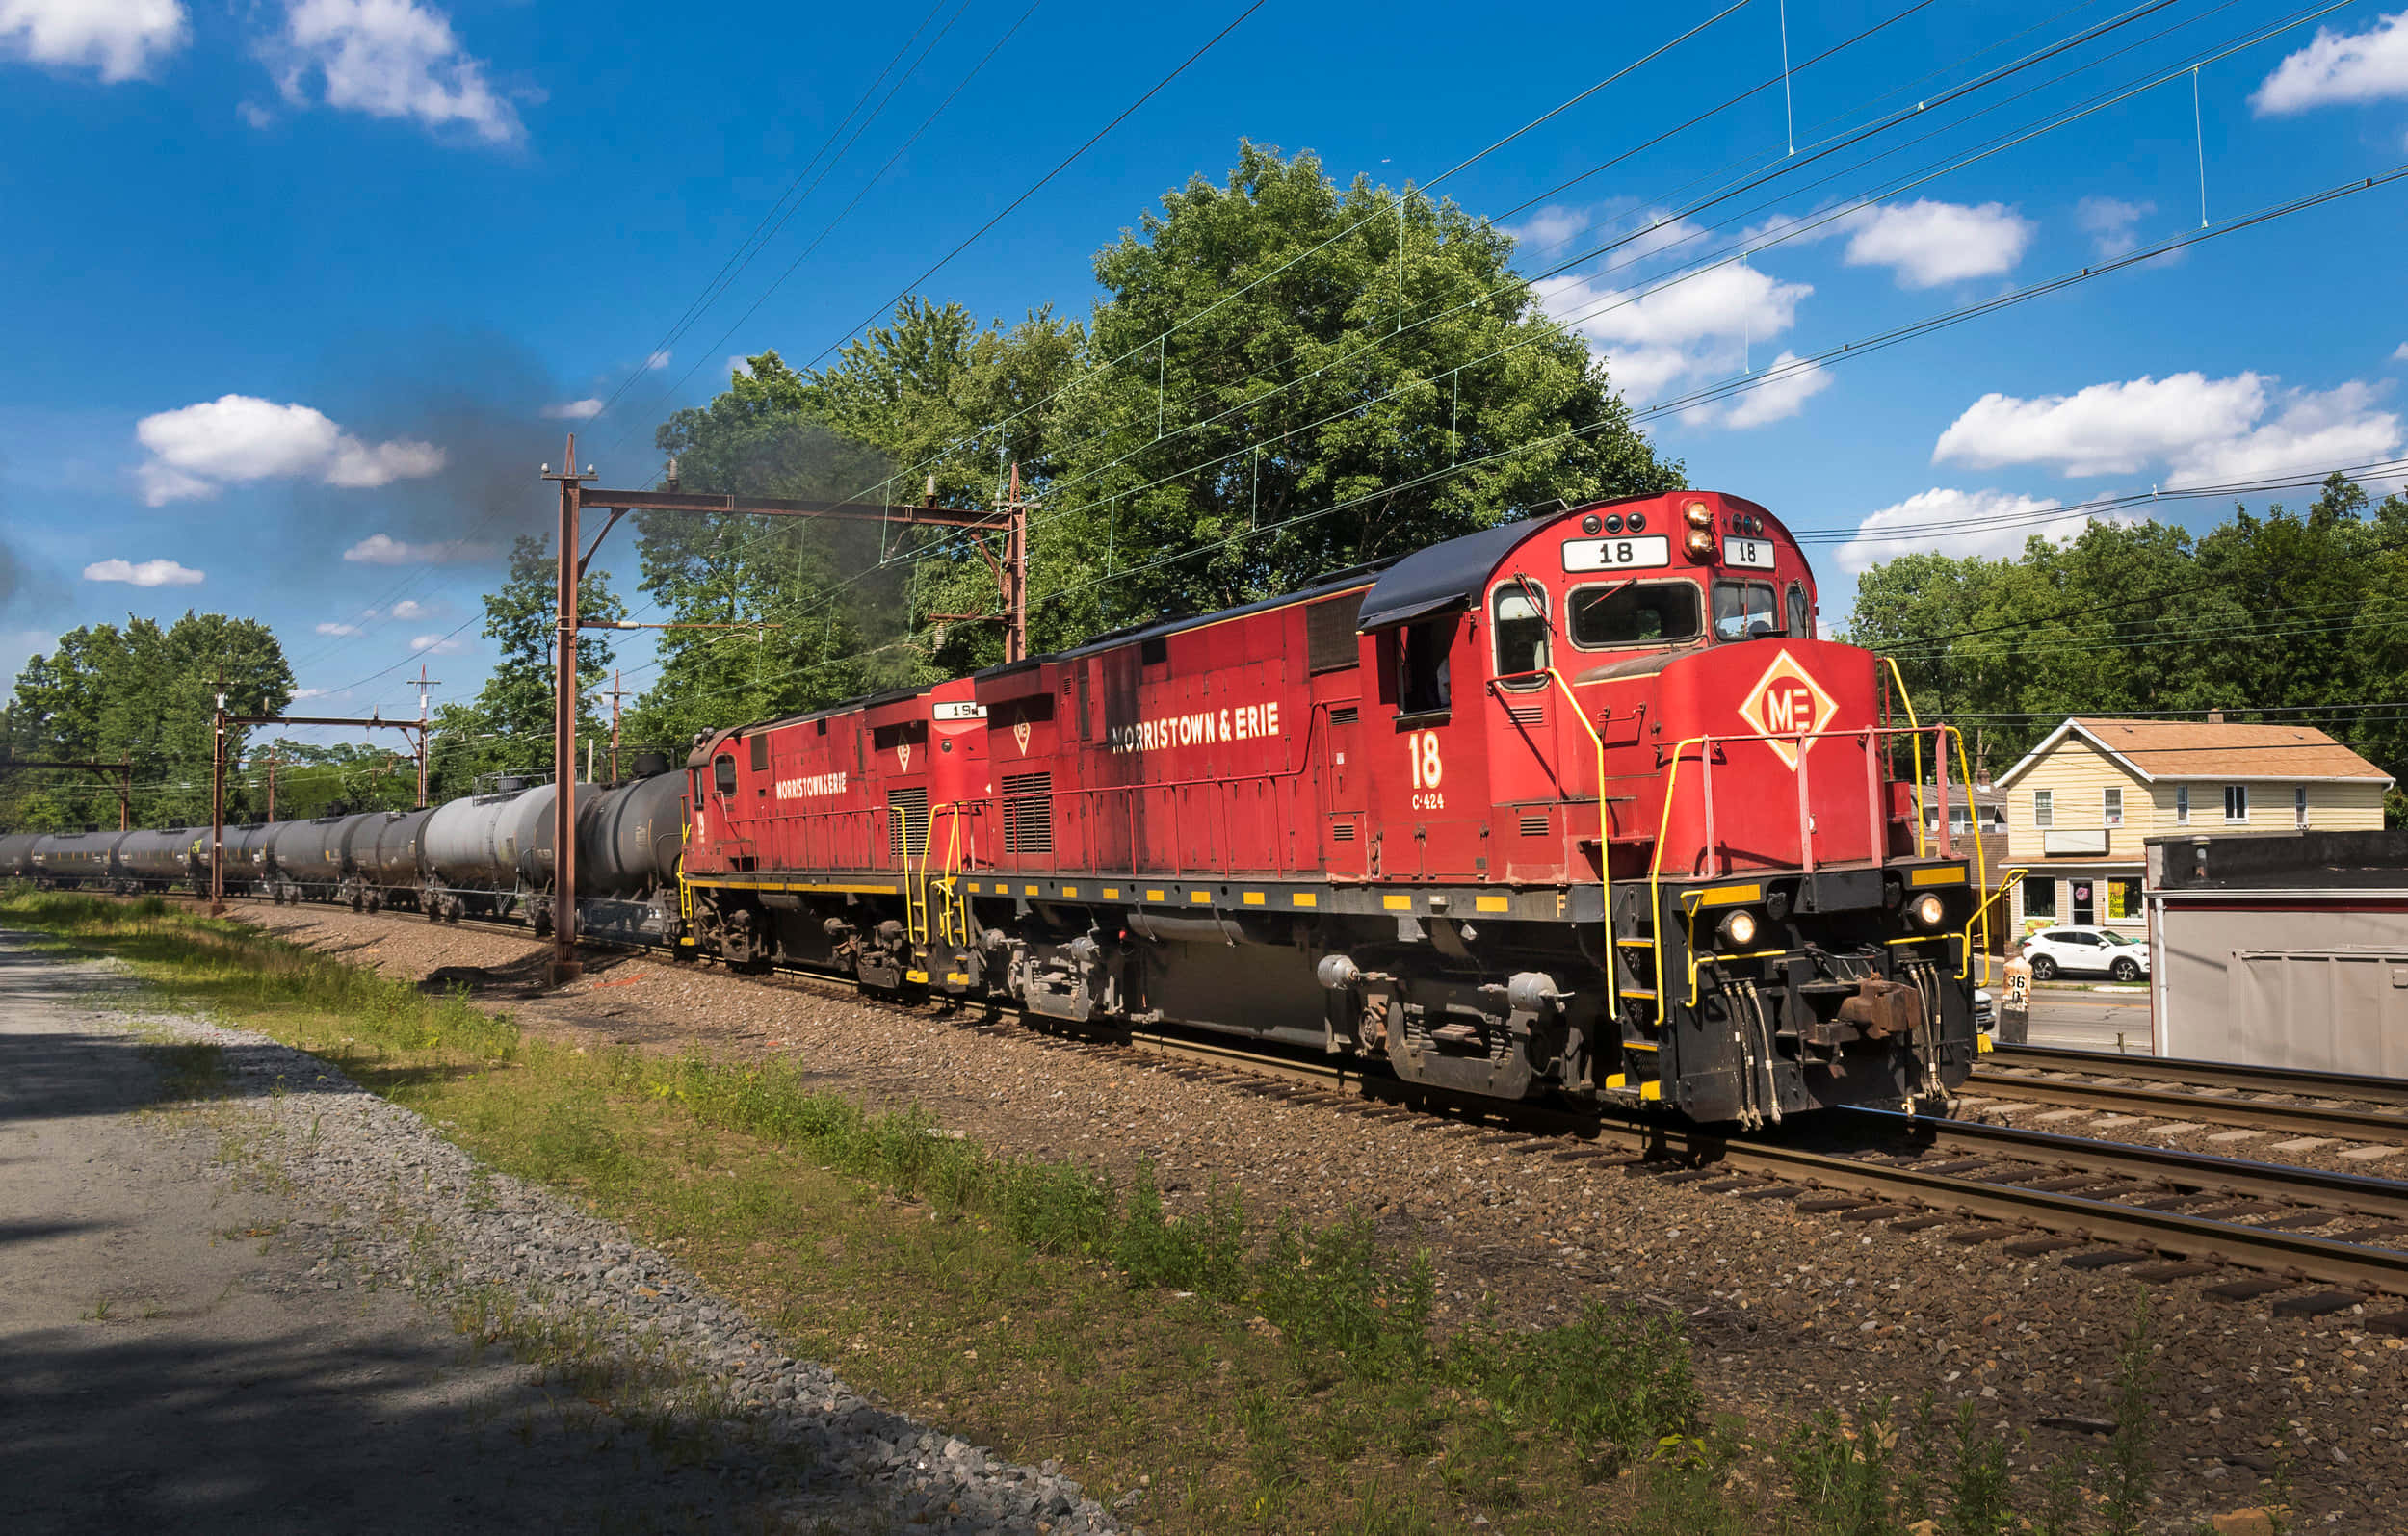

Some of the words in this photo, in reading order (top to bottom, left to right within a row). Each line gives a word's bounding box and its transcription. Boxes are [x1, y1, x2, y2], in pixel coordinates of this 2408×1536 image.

[1600, 542, 1634, 564] 18
[1740, 542, 1756, 563] 18
[1112, 711, 1216, 755] MORRISTOWN
[1218, 708, 1232, 742] &
[1235, 701, 1279, 741] ERIE
[1767, 688, 1810, 732] ME
[1408, 730, 1443, 790] 18
